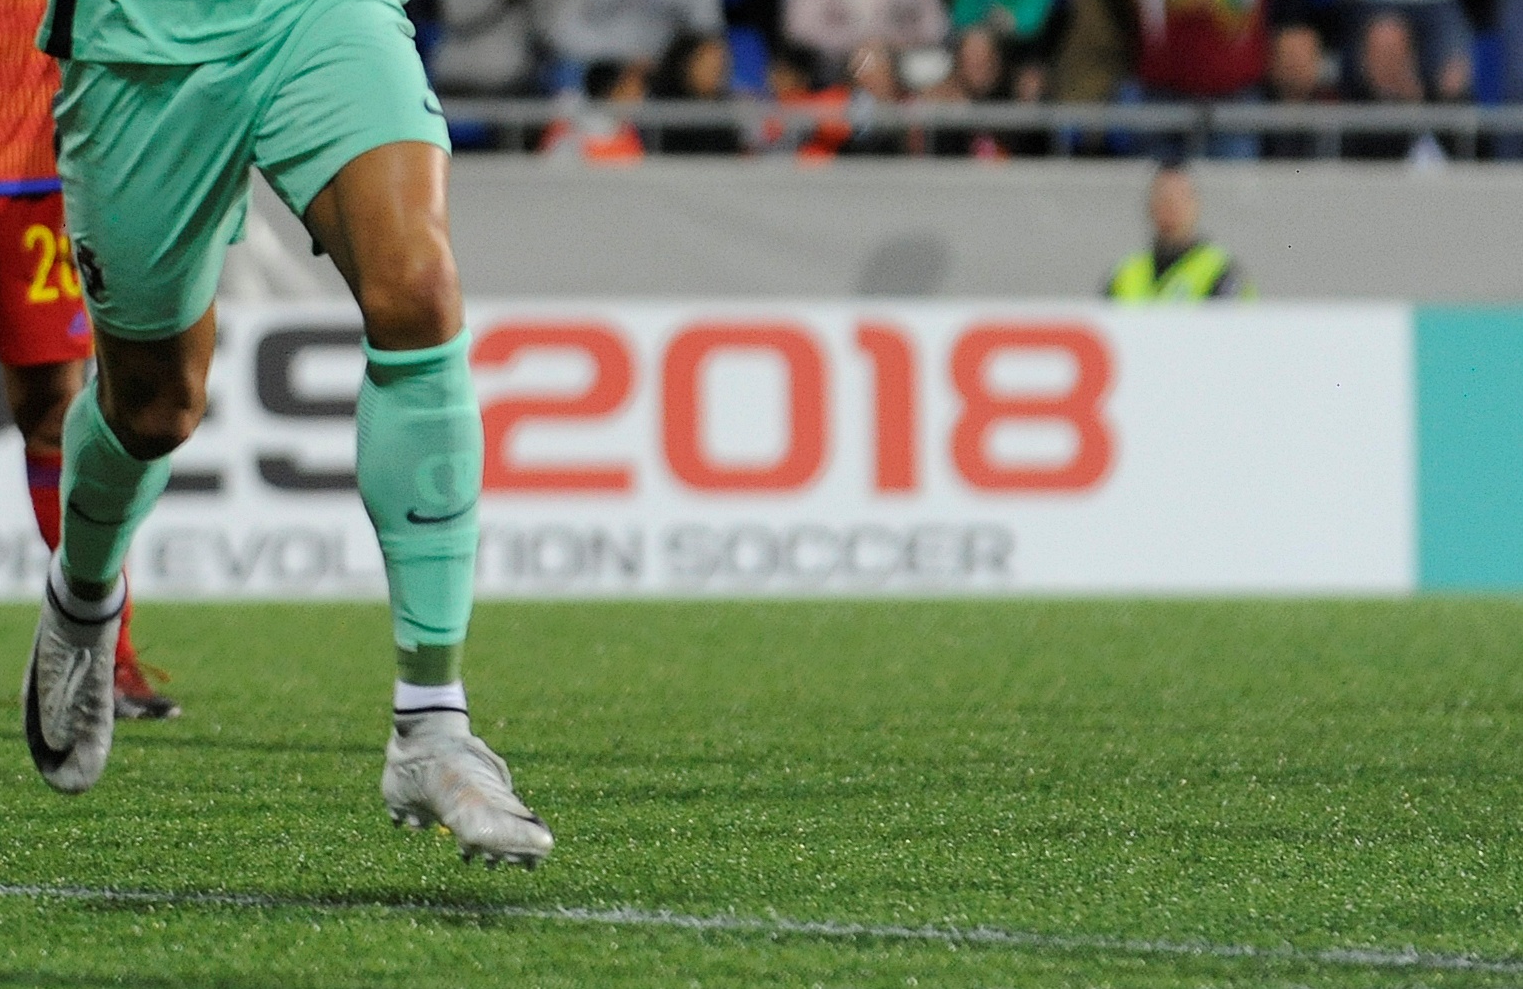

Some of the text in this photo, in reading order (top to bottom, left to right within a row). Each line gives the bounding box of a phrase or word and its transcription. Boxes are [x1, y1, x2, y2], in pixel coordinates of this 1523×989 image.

[468, 323, 1116, 494] 2018
[150, 520, 646, 583] EVOLION
[662, 520, 1018, 580] SOCCER
